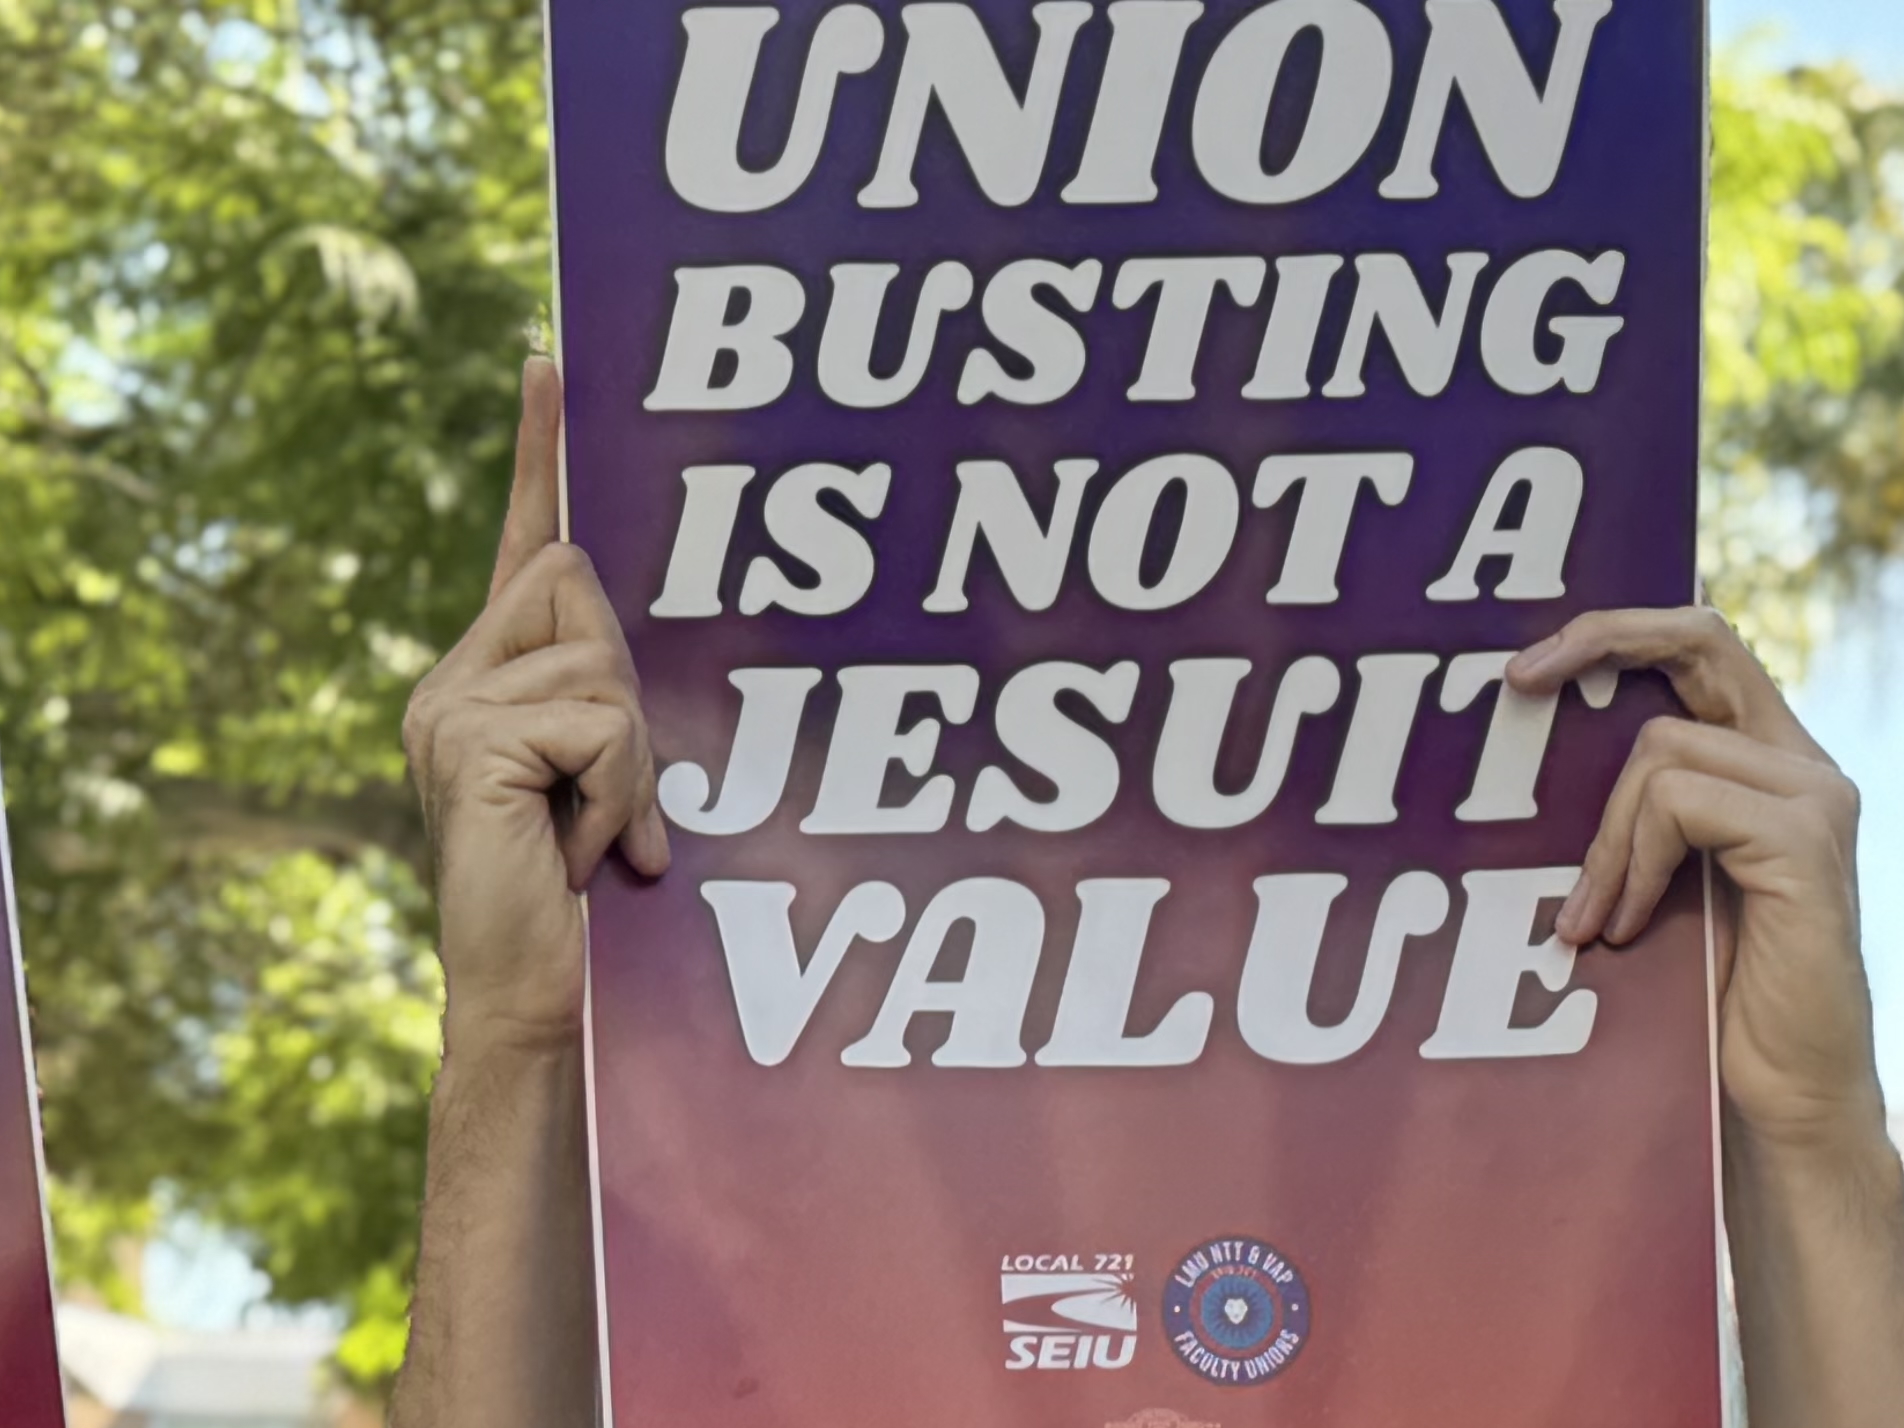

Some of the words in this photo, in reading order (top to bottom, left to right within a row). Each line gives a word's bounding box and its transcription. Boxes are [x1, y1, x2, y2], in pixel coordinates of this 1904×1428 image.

[663, 0, 1612, 212] UNION
[644, 249, 1625, 410] BUSTING
[650, 463, 891, 617] IS
[923, 451, 1414, 612] NOT
[1425, 446, 1584, 600] A
[656, 650, 1618, 835] JESUIT
[699, 865, 1598, 1067] VALUE
[1001, 1254, 1084, 1272] LOCAL
[1094, 1254, 1135, 1271] 721
[1174, 1250, 1208, 1289] LMU
[1208, 1241, 1243, 1264] NTT
[1005, 1335, 1138, 1370] SEIU
[1174, 1329, 1240, 1381] FACULTY
